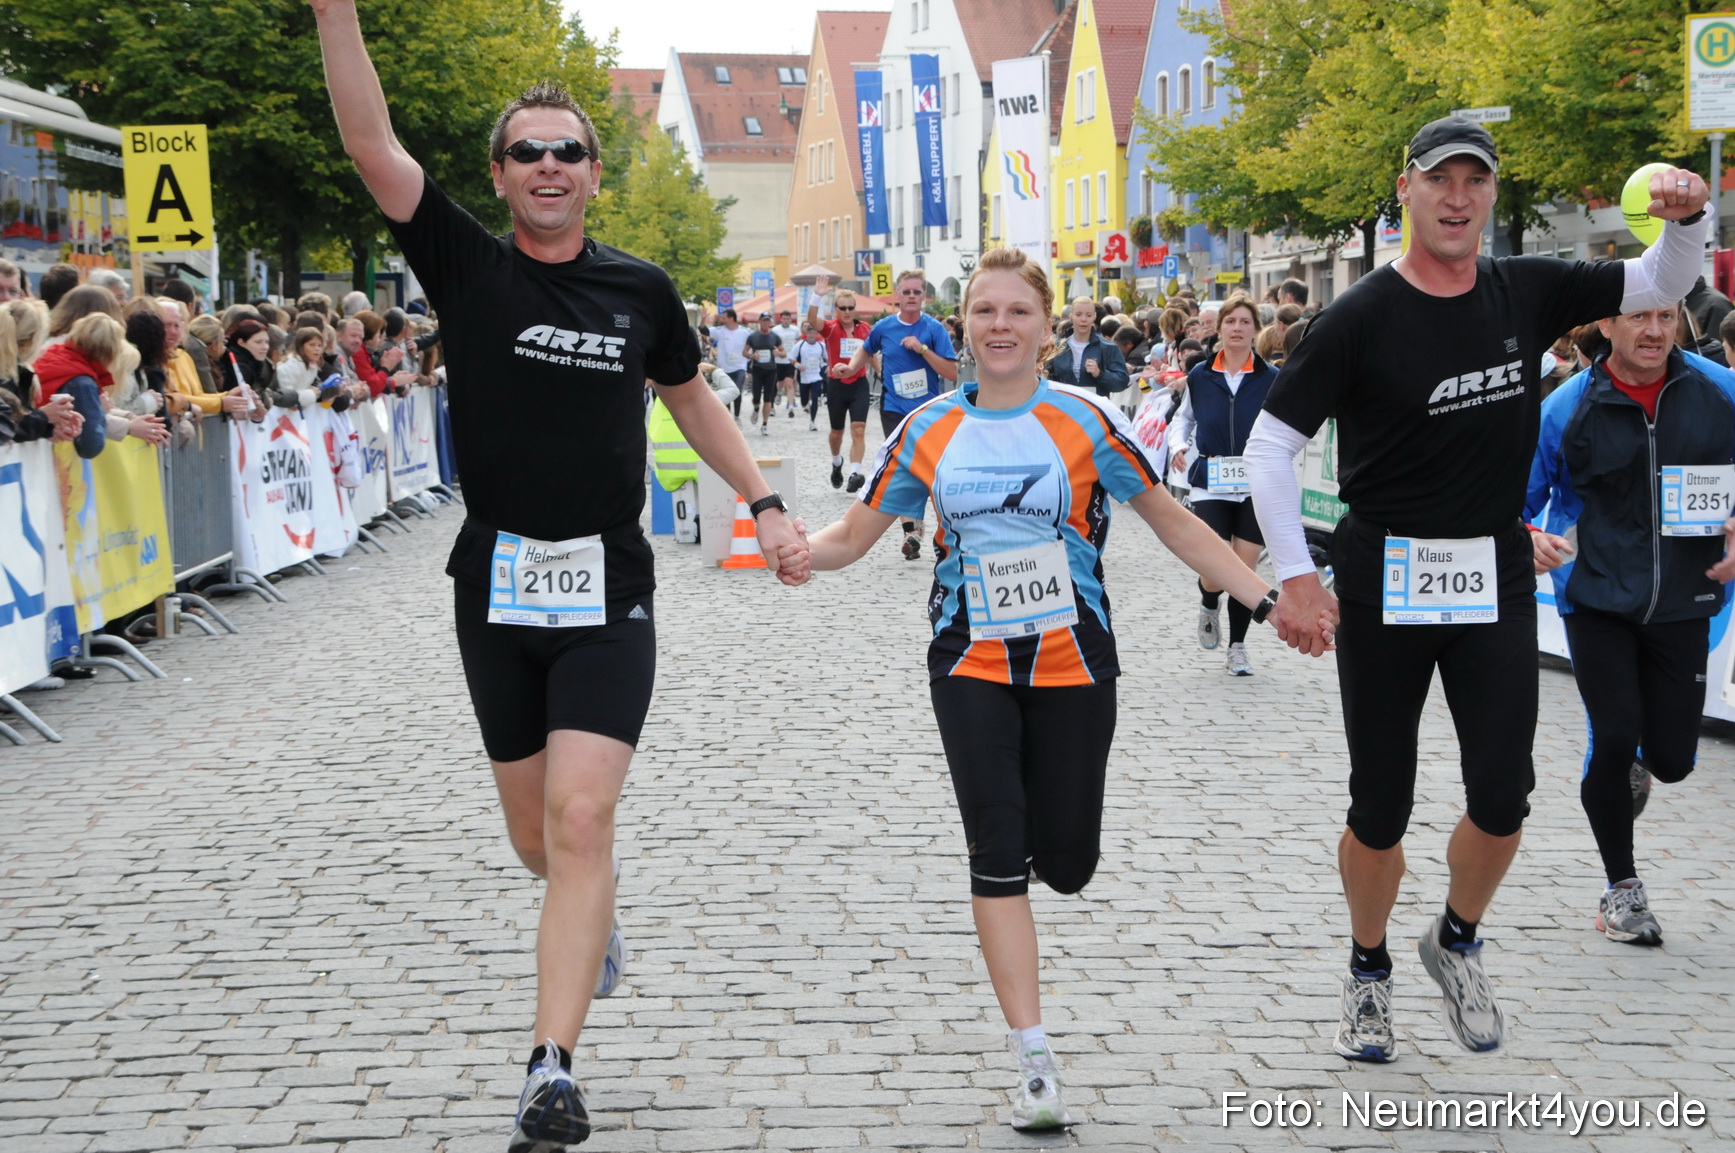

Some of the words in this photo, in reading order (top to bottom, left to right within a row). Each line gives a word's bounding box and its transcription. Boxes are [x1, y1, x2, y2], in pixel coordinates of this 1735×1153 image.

[1485, 110, 1506, 119] Gasse
[132, 130, 197, 153] Block
[929, 116, 941, 177] RUPPERT
[146, 164, 194, 223] A
[933, 179, 942, 203] K&L
[1166, 258, 1175, 277] P
[877, 274, 888, 289] B
[514, 346, 624, 372] www.arzt-reisen.de
[904, 379, 924, 391] 3552
[1428, 385, 1525, 416] www.arzt-reisen.de
[1222, 467, 1247, 478] 315
[1687, 473, 1720, 485] Ottmar
[945, 480, 1023, 496] SPEED
[1668, 492, 1674, 502] C
[1687, 492, 1729, 511] 2351
[950, 507, 1005, 521] RACING
[1010, 507, 1051, 517] TEAM
[1417, 547, 1453, 562] Klaus
[987, 558, 1037, 577] Kerstin
[523, 570, 591, 594] 2102
[1418, 571, 1484, 594] 2103
[995, 575, 1061, 608] 2104
[559, 612, 603, 620] PFLEIDERER
[1036, 611, 1076, 627] PFLEIDERER
[1453, 611, 1495, 619] PFLEIDERER
